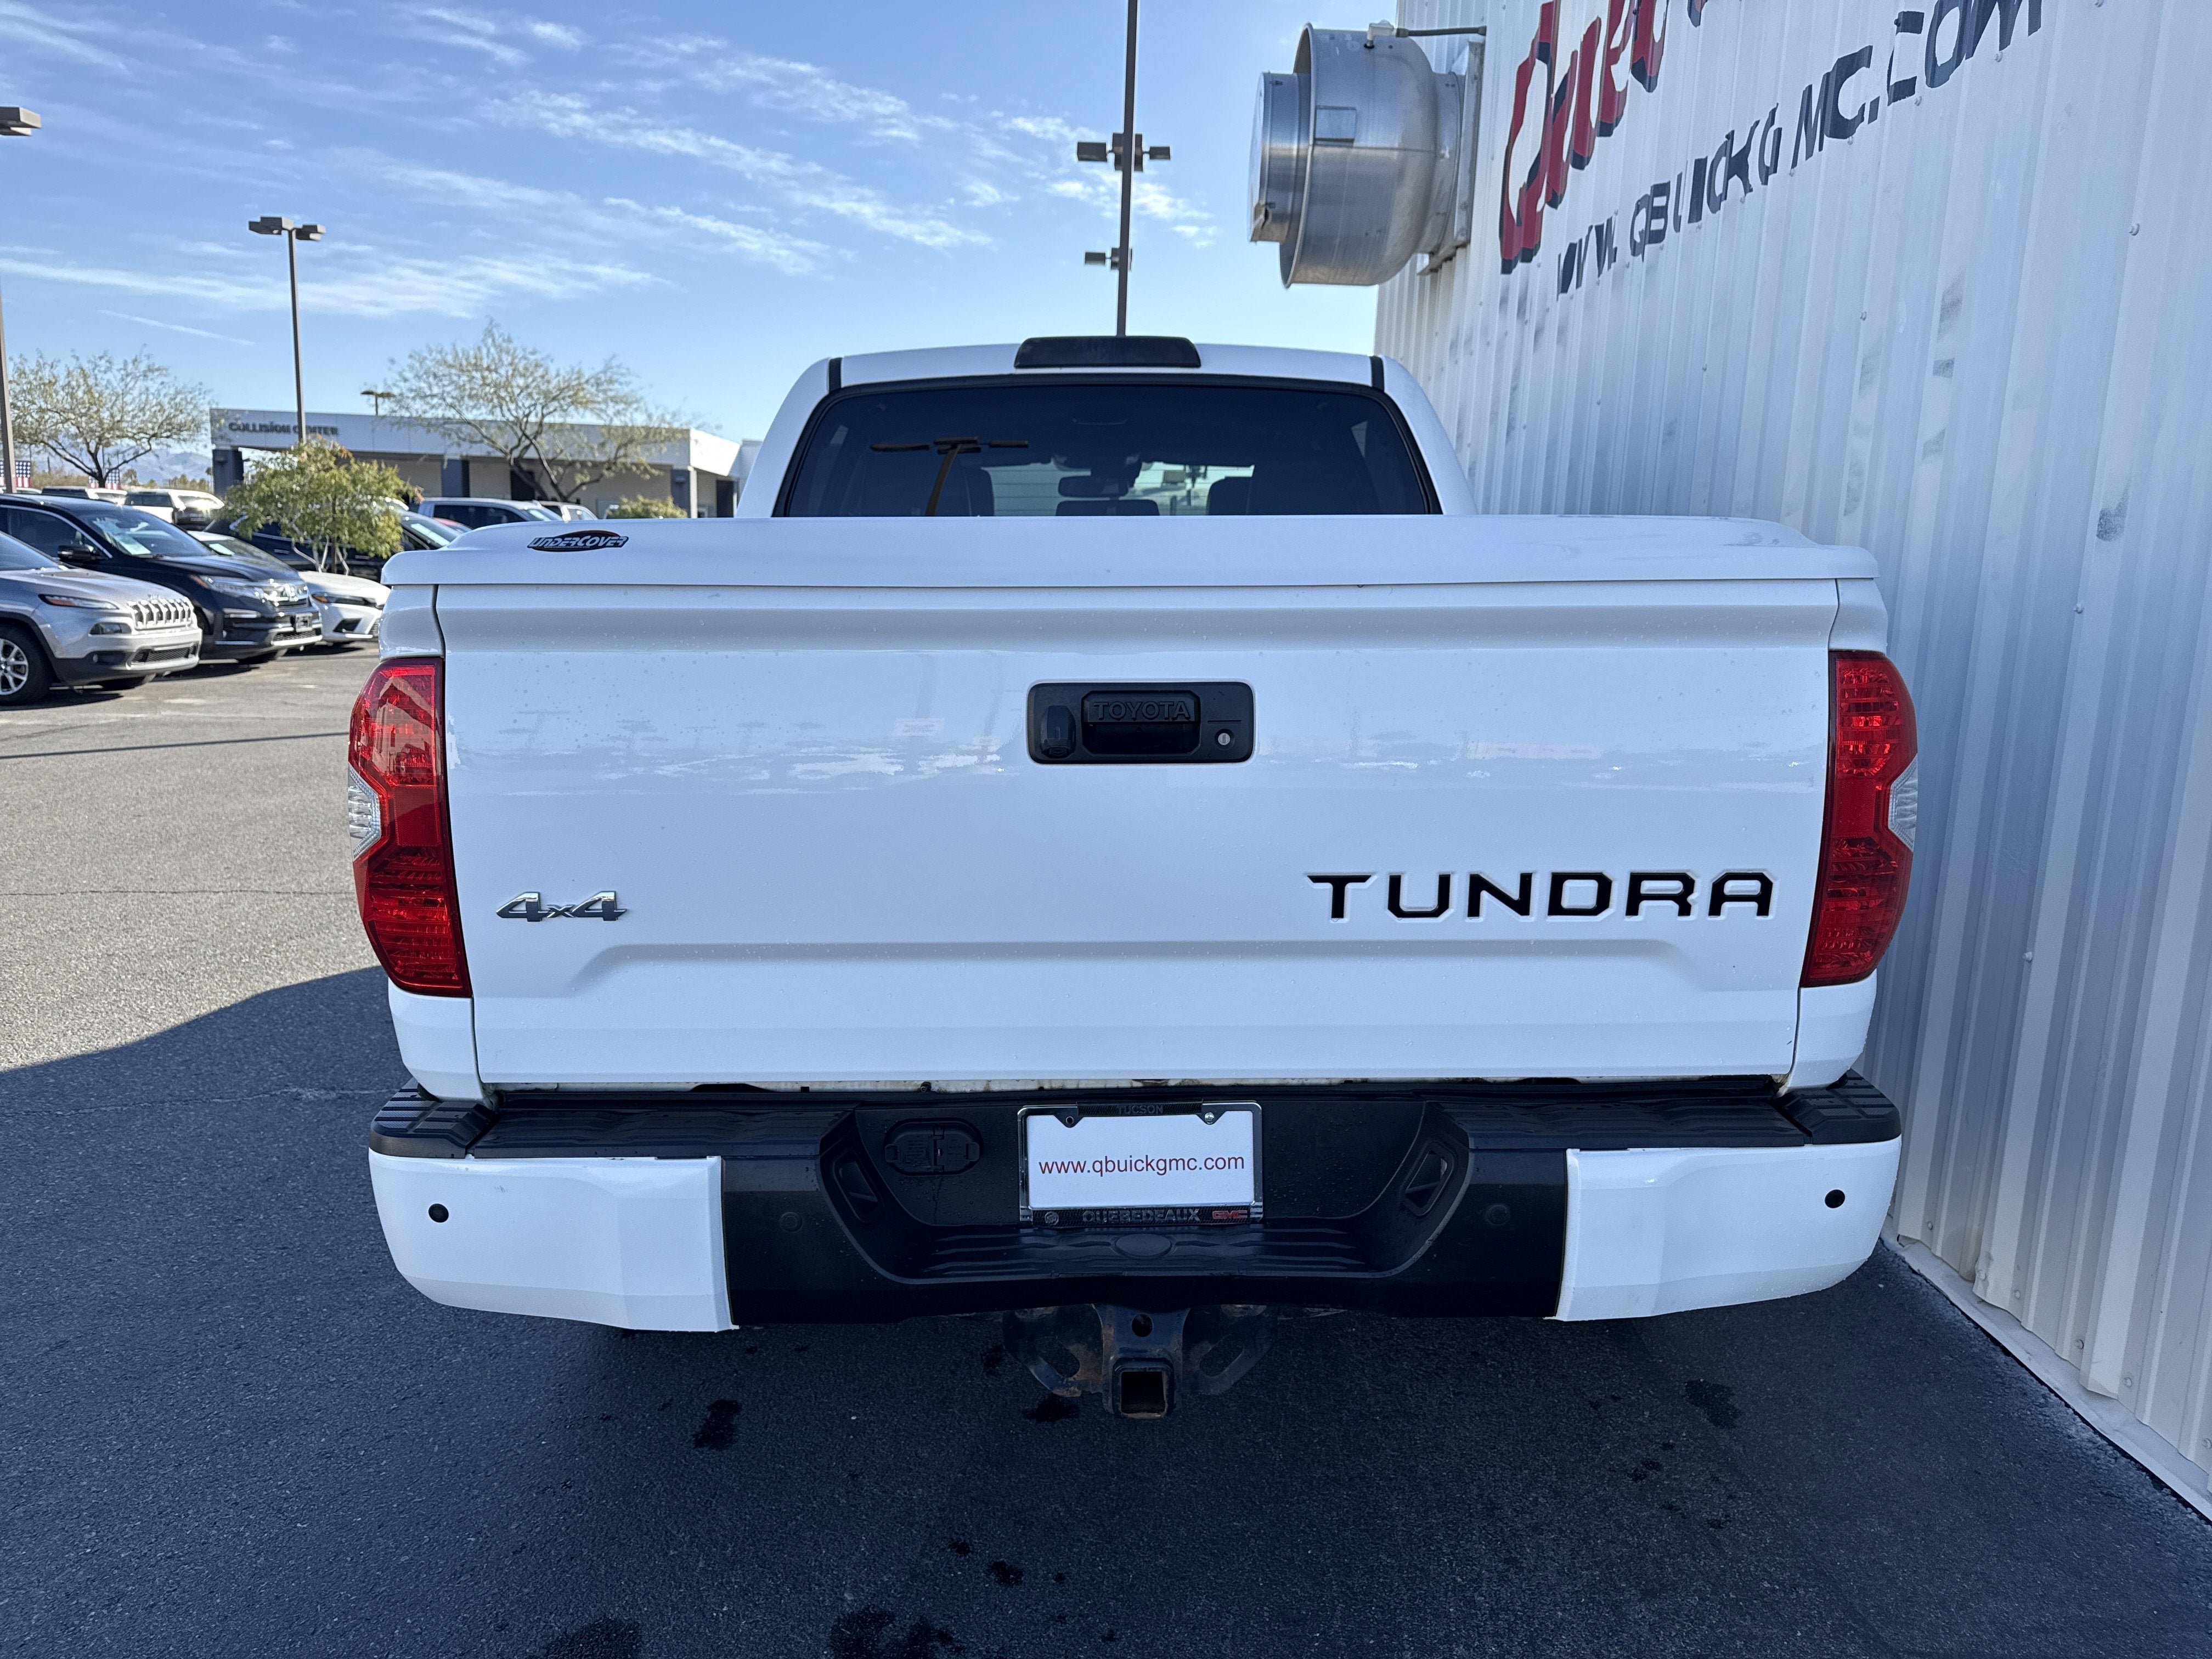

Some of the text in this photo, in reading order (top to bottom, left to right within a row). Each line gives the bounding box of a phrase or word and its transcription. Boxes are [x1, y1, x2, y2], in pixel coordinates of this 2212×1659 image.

[228, 421, 338, 435] COLLISION CNTER
[528, 535, 628, 547] UNDERCOVER
[1093, 700, 1192, 721] TOYOTA
[1306, 871, 1774, 919] TUNDRA
[1117, 1104, 1164, 1115] TUCSON
[1039, 1155, 1245, 1177] www.qbuickgmc.com
[1082, 1209, 1248, 1222] QUEBEDEAUX GMC
